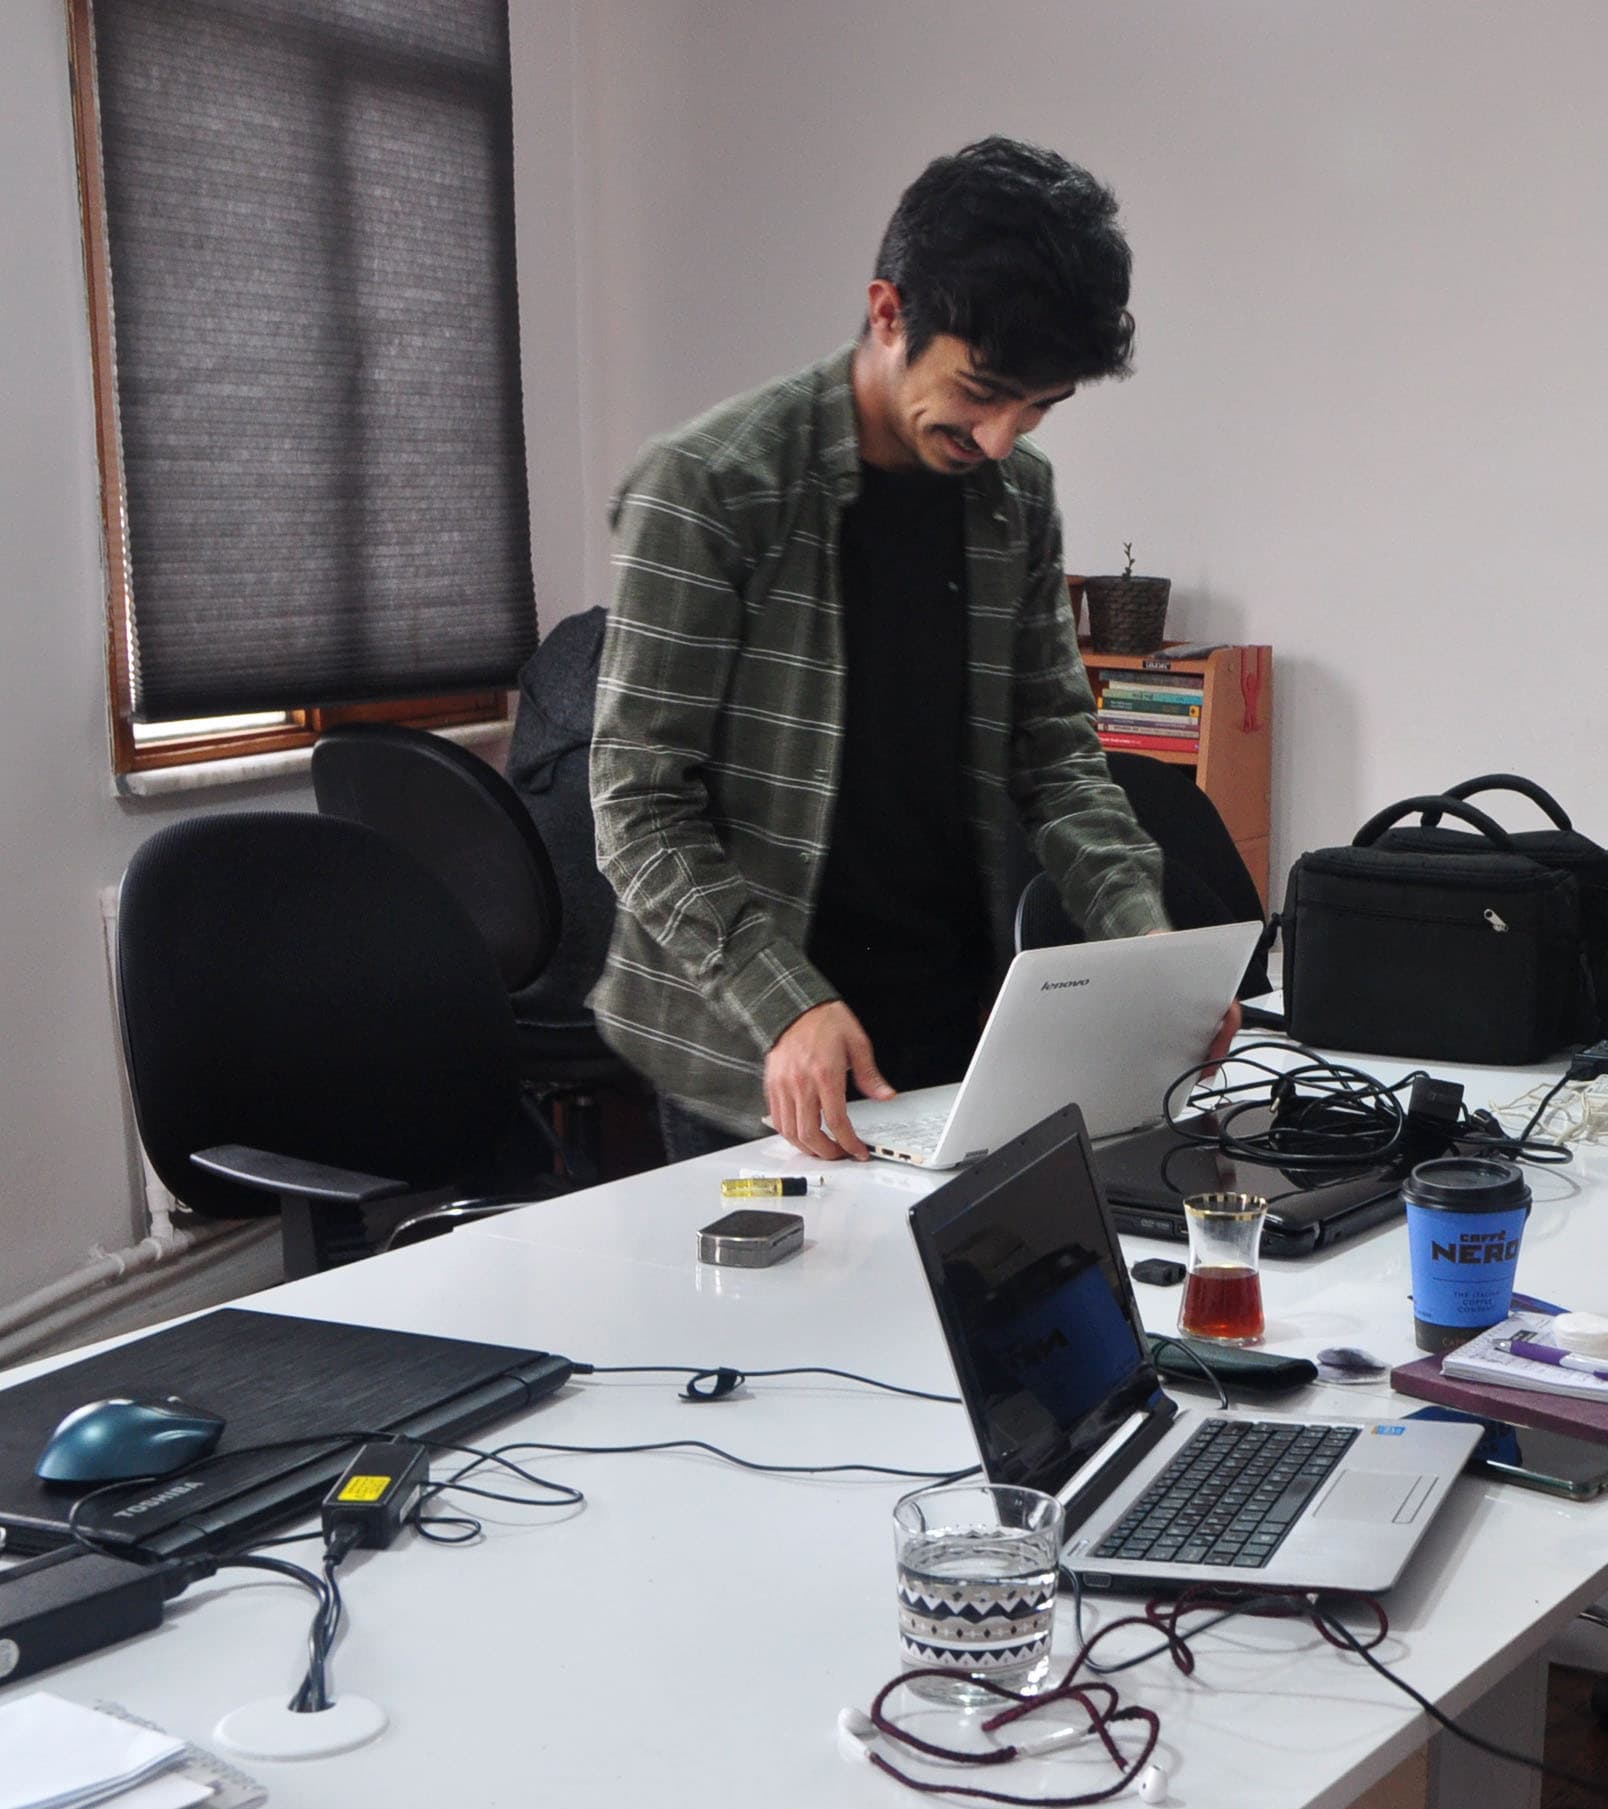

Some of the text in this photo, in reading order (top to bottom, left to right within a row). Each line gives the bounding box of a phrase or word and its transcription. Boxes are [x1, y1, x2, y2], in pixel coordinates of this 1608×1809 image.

[1041, 979, 1090, 991] lenovo
[1431, 1238, 1520, 1264] NERO
[1454, 1290, 1469, 1298] THE
[1462, 1298, 1494, 1306] COFFEE
[112, 1481, 206, 1517] TOSHIBA
